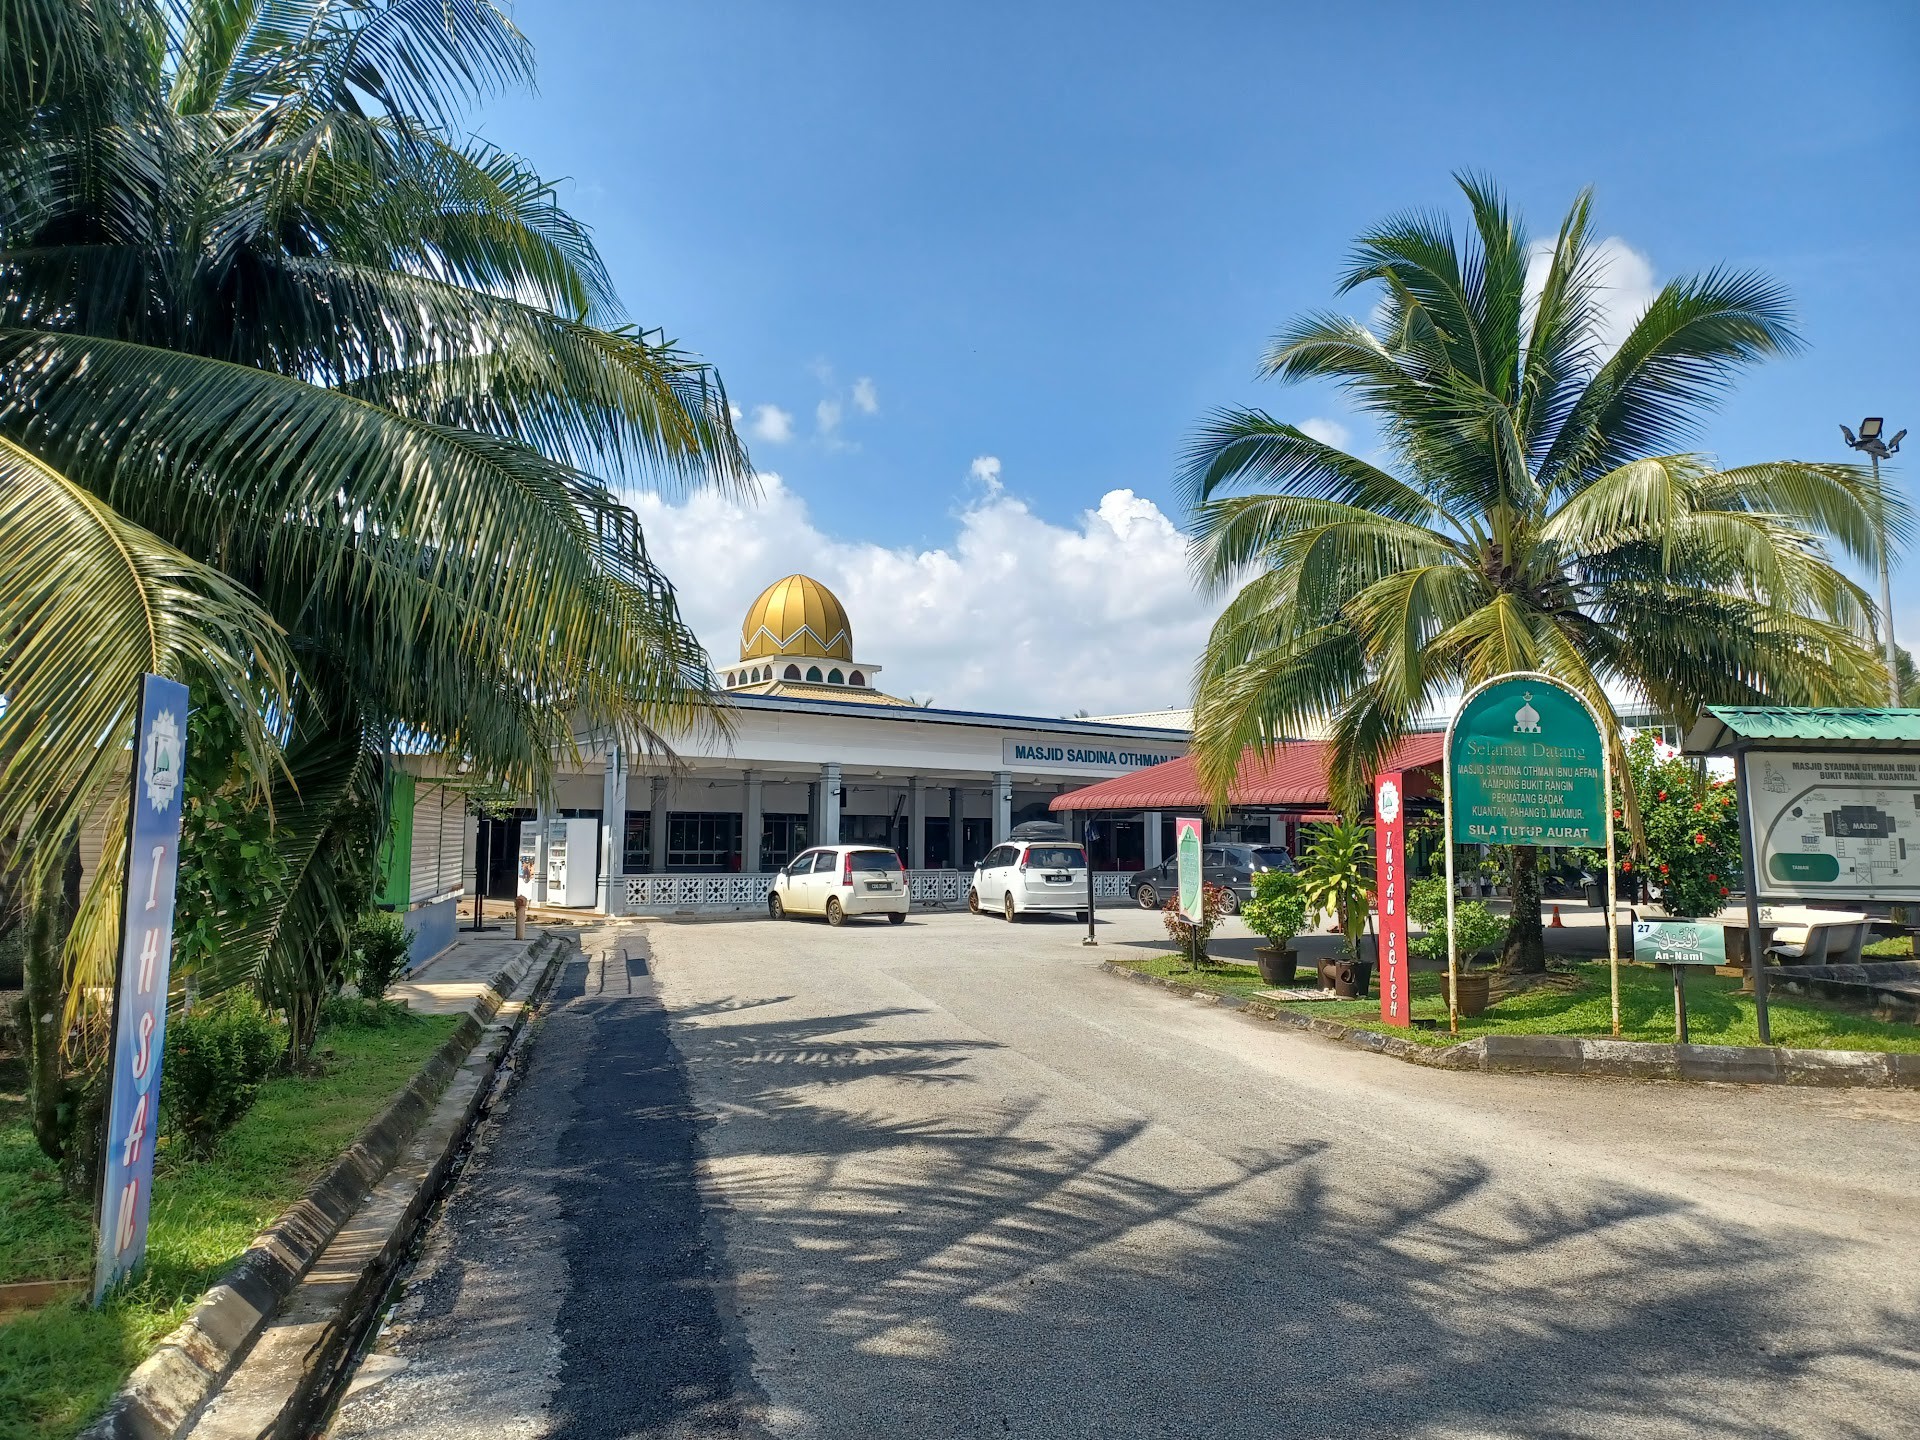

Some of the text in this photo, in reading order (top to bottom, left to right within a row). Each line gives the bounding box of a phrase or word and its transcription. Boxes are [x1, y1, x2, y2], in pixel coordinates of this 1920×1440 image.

[1015, 746, 1064, 761] MASJID
[1067, 749, 1117, 765] SAIDINA
[1119, 753, 1168, 767] OTHMAN
[1467, 741, 1586, 760] Selamat Datang
[1457, 764, 1484, 775] MASJID
[1523, 766, 1554, 777] OTHMAN
[1556, 766, 1573, 778] IBNU
[1574, 767, 1598, 779] AFFAN
[1791, 762, 1822, 771] MASJID
[1824, 763, 1860, 771] SYAIDINA
[1861, 763, 1895, 772] OTHMAN
[1896, 764, 1916, 773] IBNU
[1820, 771, 1843, 780] BUKIT
[1482, 779, 1574, 792] KAMPUNG BUKIT RANGIN
[1491, 793, 1564, 805] PERMATANG BADAK
[1510, 807, 1540, 818] PAHANG
[1468, 825, 1589, 838] SILA TUTUP AURAT
[1852, 822, 1878, 830] MASJID
[1637, 924, 1650, 933] 27
[1654, 951, 1703, 961] An-Naml
[114, 846, 165, 1256] IHSAN
